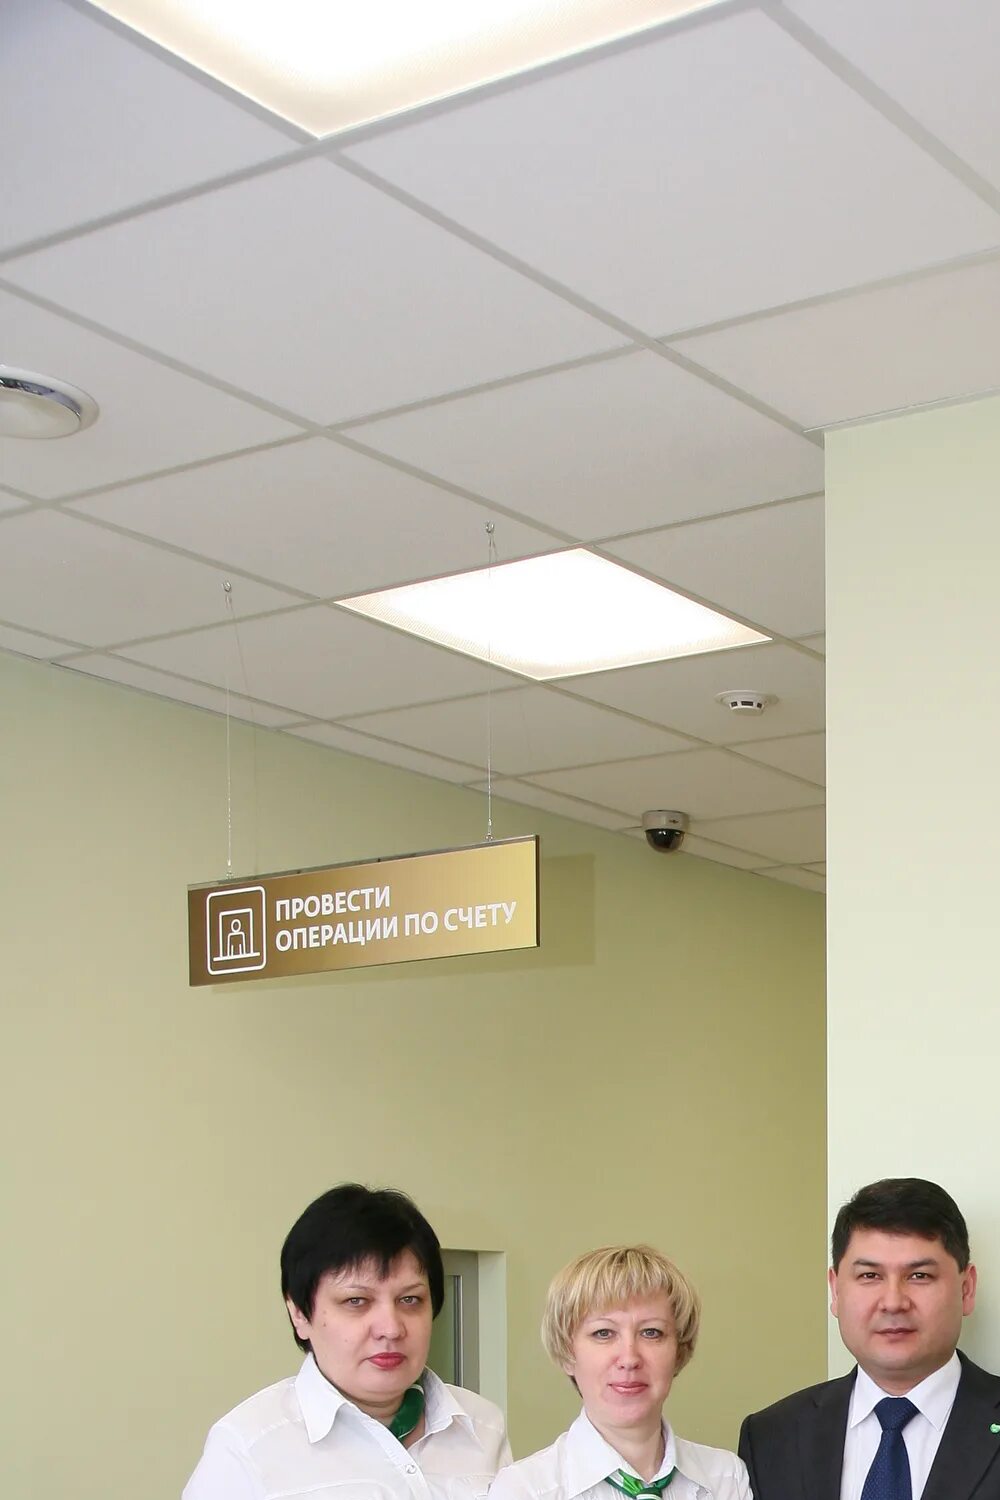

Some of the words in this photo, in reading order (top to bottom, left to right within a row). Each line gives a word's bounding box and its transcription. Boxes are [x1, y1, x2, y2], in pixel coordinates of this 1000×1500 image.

[275, 885, 391, 922] ПРОВЕСТИ
[275, 915, 399, 952] ОПЕРАЦИИ
[404, 911, 439, 937] ПО
[443, 901, 517, 932] СЧЕТУ
